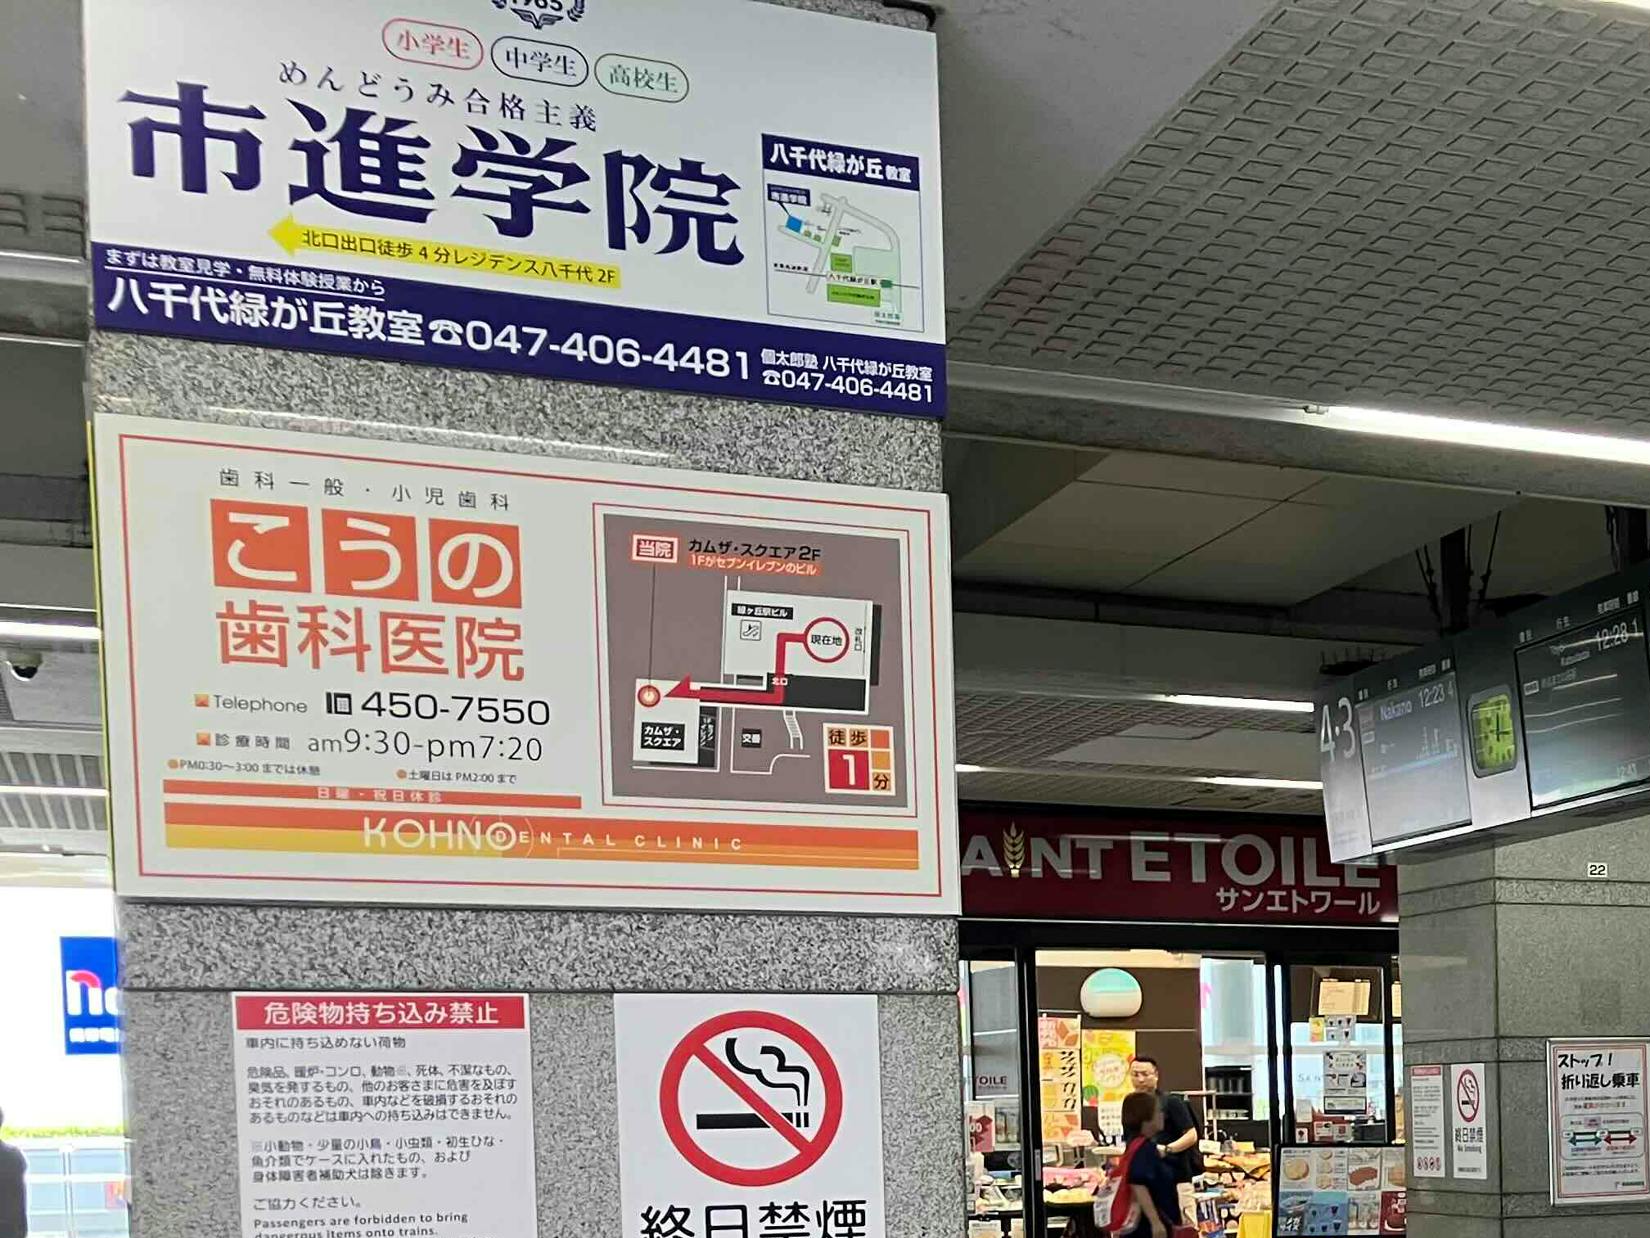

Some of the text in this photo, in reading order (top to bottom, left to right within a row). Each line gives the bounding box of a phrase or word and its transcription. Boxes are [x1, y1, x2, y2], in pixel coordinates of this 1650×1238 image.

[396, 29, 471, 60] 小学生
[506, 46, 577, 78] 中学生
[609, 64, 678, 93] 高校生
[279, 60, 597, 132] めんどうみ合格主義
[117, 80, 745, 267] 市進学院
[105, 249, 386, 296] まずは教室見学・無料体験授業から
[106, 276, 749, 380] 八千代緑が丘教室 047-406-4481
[823, 355, 934, 382] 八千代緑が丘教室
[780, 370, 933, 403] 047-406-4481
[219, 467, 510, 511] 歯科一般・小児歯科
[226, 511, 515, 600] こうの
[638, 541, 672, 558] 当院
[690, 554, 818, 576] 1Fがセブンイレブンのビル
[215, 600, 525, 682] 歯科医院
[809, 633, 844, 647] 現在地
[213, 691, 551, 726] Telephone 450-7550
[214, 728, 544, 762] 診療時間 am9:30-pm7:20
[643, 736, 682, 748] スクエア
[828, 728, 868, 746] 徒歩
[842, 753, 857, 786] 1
[873, 773, 890, 790] 分
[361, 816, 517, 851] KOHNO
[634, 834, 743, 850] CLINIC
[961, 830, 1381, 889] AINT ETOILE
[1588, 865, 1606, 876] 22
[1216, 887, 1382, 916] サンエトワール
[264, 1001, 499, 1026] 危険物持ち込み禁止
[245, 1035, 407, 1050] 車内に持ち込めない荷物
[1560, 1072, 1641, 1090] 折り返し乗車
[249, 1107, 514, 1125] あるものなどは車内への持ち込みはできません。
[252, 1195, 363, 1212] ご協力ください。
[253, 1211, 469, 1230] Passengers are forbidden to bring
[365, 1228, 395, 1238] onto
[398, 1226, 439, 1238] trains.
